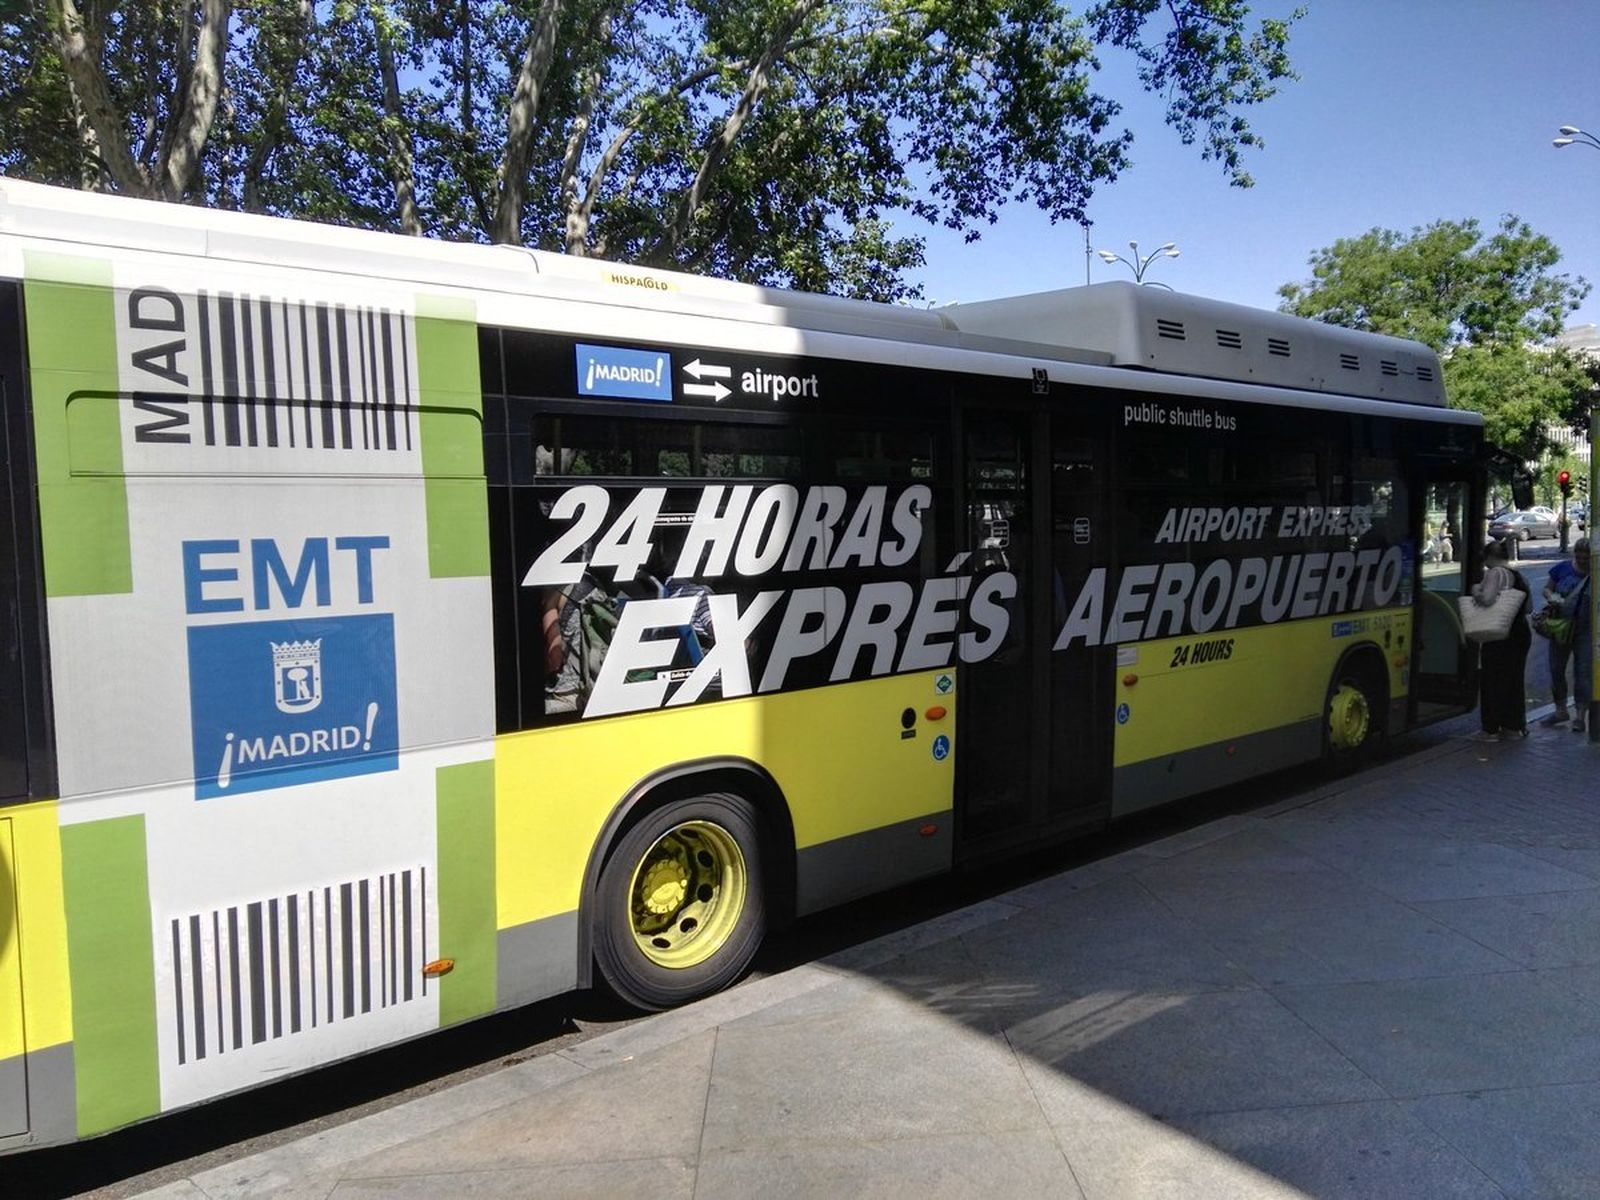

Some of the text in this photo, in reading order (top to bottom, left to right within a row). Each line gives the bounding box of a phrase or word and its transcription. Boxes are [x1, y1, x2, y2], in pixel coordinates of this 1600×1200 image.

[128, 287, 191, 444] MAD
[586, 357, 663, 389] ¡MADRID!
[741, 367, 819, 402] airport
[1123, 403, 1237, 431] public shuttle bus
[522, 484, 932, 587] 24 HORAS
[1154, 504, 1372, 544] AIRPORT EXPRESS
[182, 536, 390, 614] EMT
[582, 546, 1404, 719] EXPRÉS AEROPUERTO
[1170, 639, 1235, 669] 24 HOURS
[218, 702, 378, 788] ¡MADRID!
